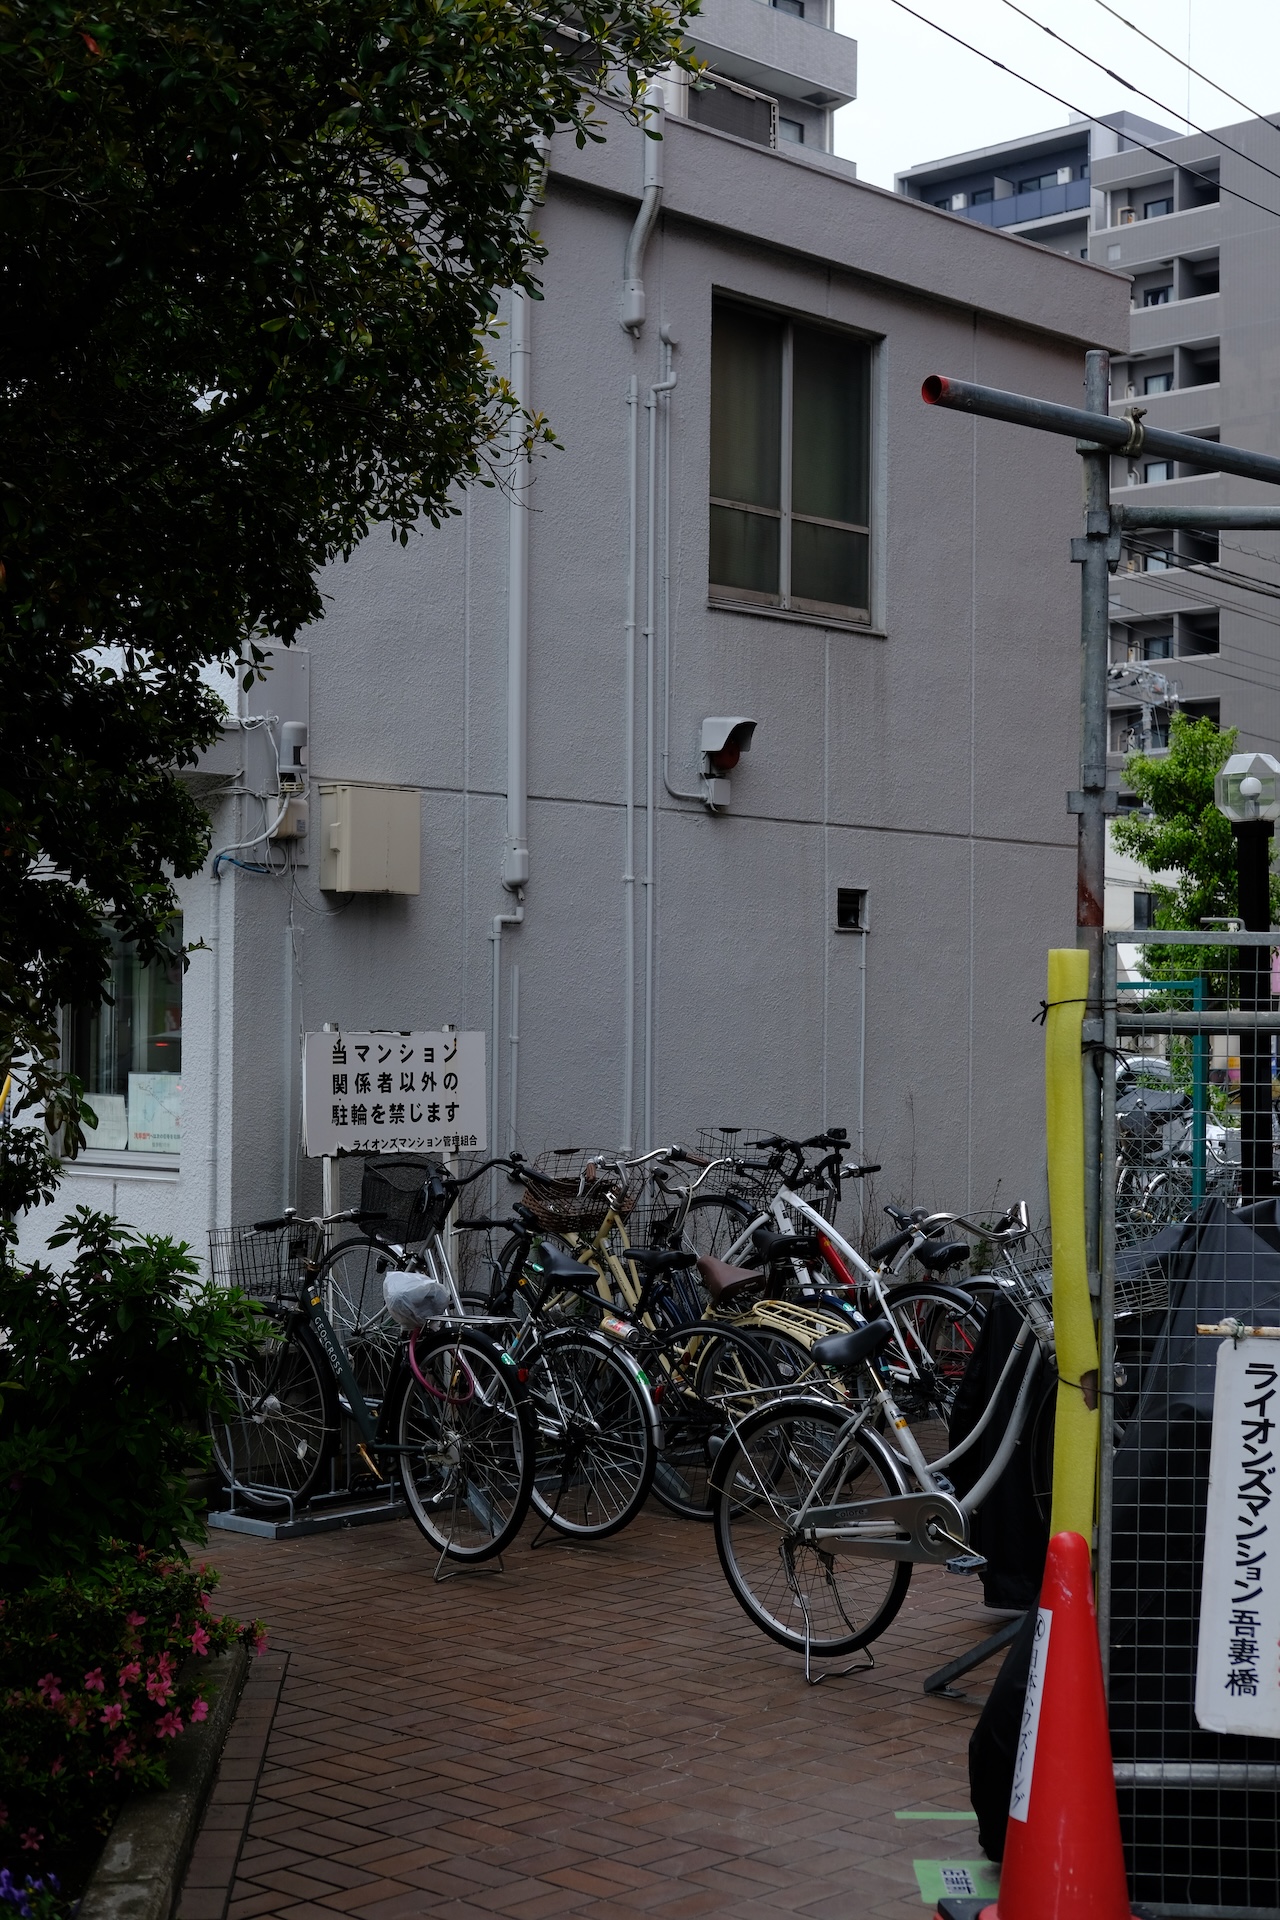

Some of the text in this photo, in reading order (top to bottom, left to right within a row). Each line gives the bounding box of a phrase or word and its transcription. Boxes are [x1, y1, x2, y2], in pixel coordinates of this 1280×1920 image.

[332, 1042, 458, 1065] 当マンション
[332, 1071, 459, 1095] 関係者以外の
[331, 1102, 460, 1126] 駐輪を禁じます
[353, 1134, 478, 1151] ライオンズマンション管理組合
[1224, 1362, 1279, 1697] ライオンズマンション吾妻橋
